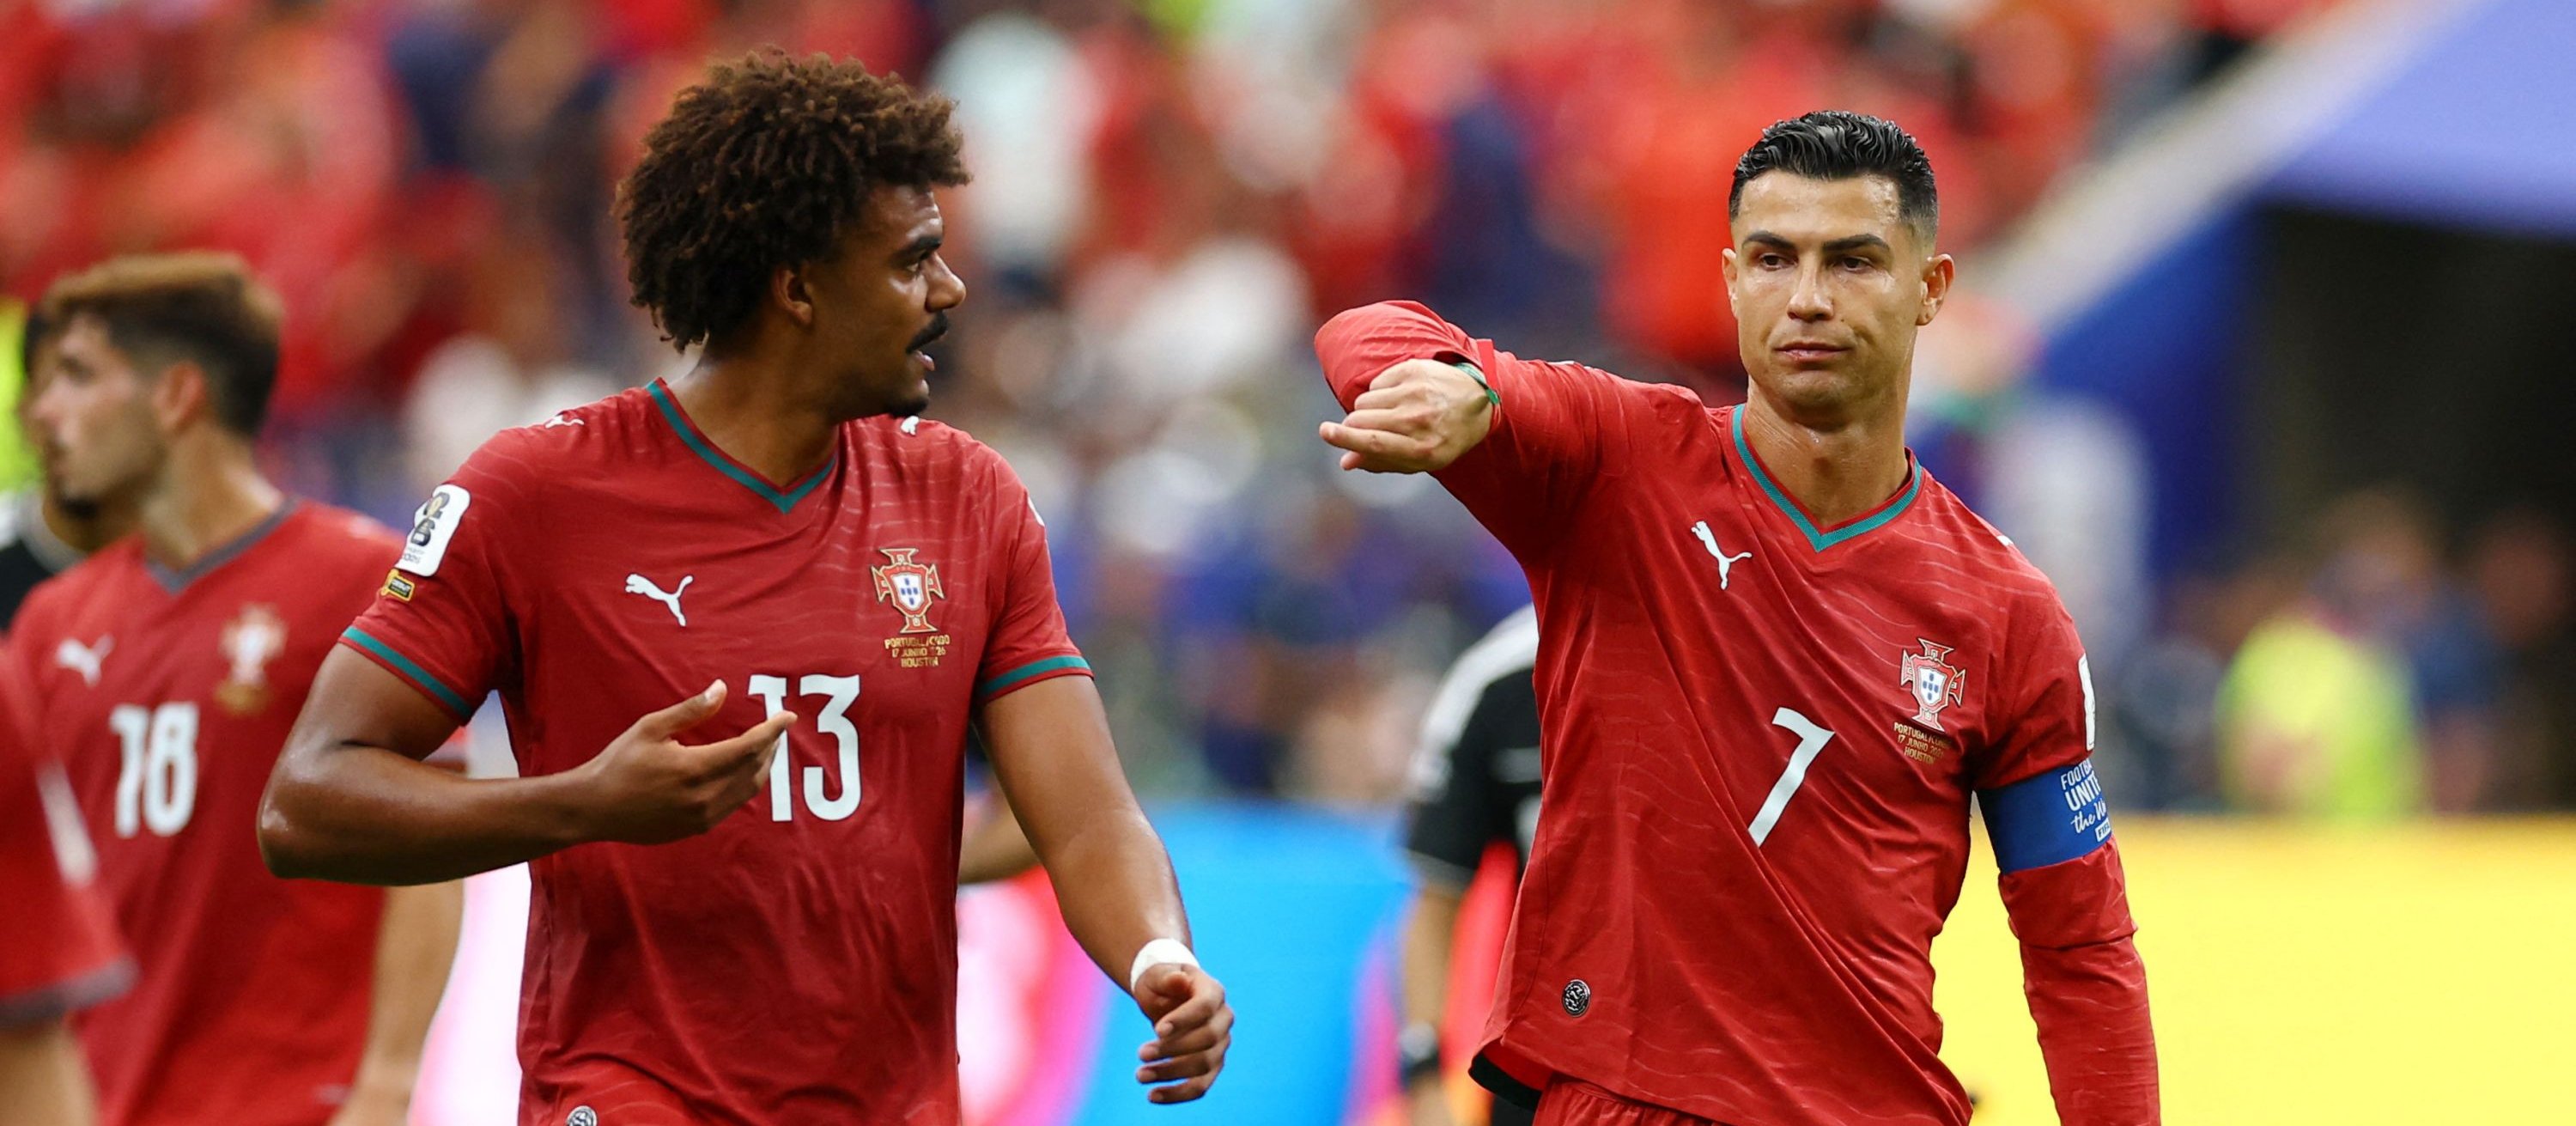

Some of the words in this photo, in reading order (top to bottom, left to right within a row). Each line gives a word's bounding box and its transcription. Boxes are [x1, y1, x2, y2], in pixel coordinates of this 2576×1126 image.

[902, 648, 927, 657] JUNO
[108, 701, 199, 839] 18
[748, 674, 861, 822] 13
[1747, 706, 1836, 848] 7
[1898, 734, 1905, 743] 17
[1906, 737, 1929, 752] JUNHO
[2070, 811, 2096, 833] the
